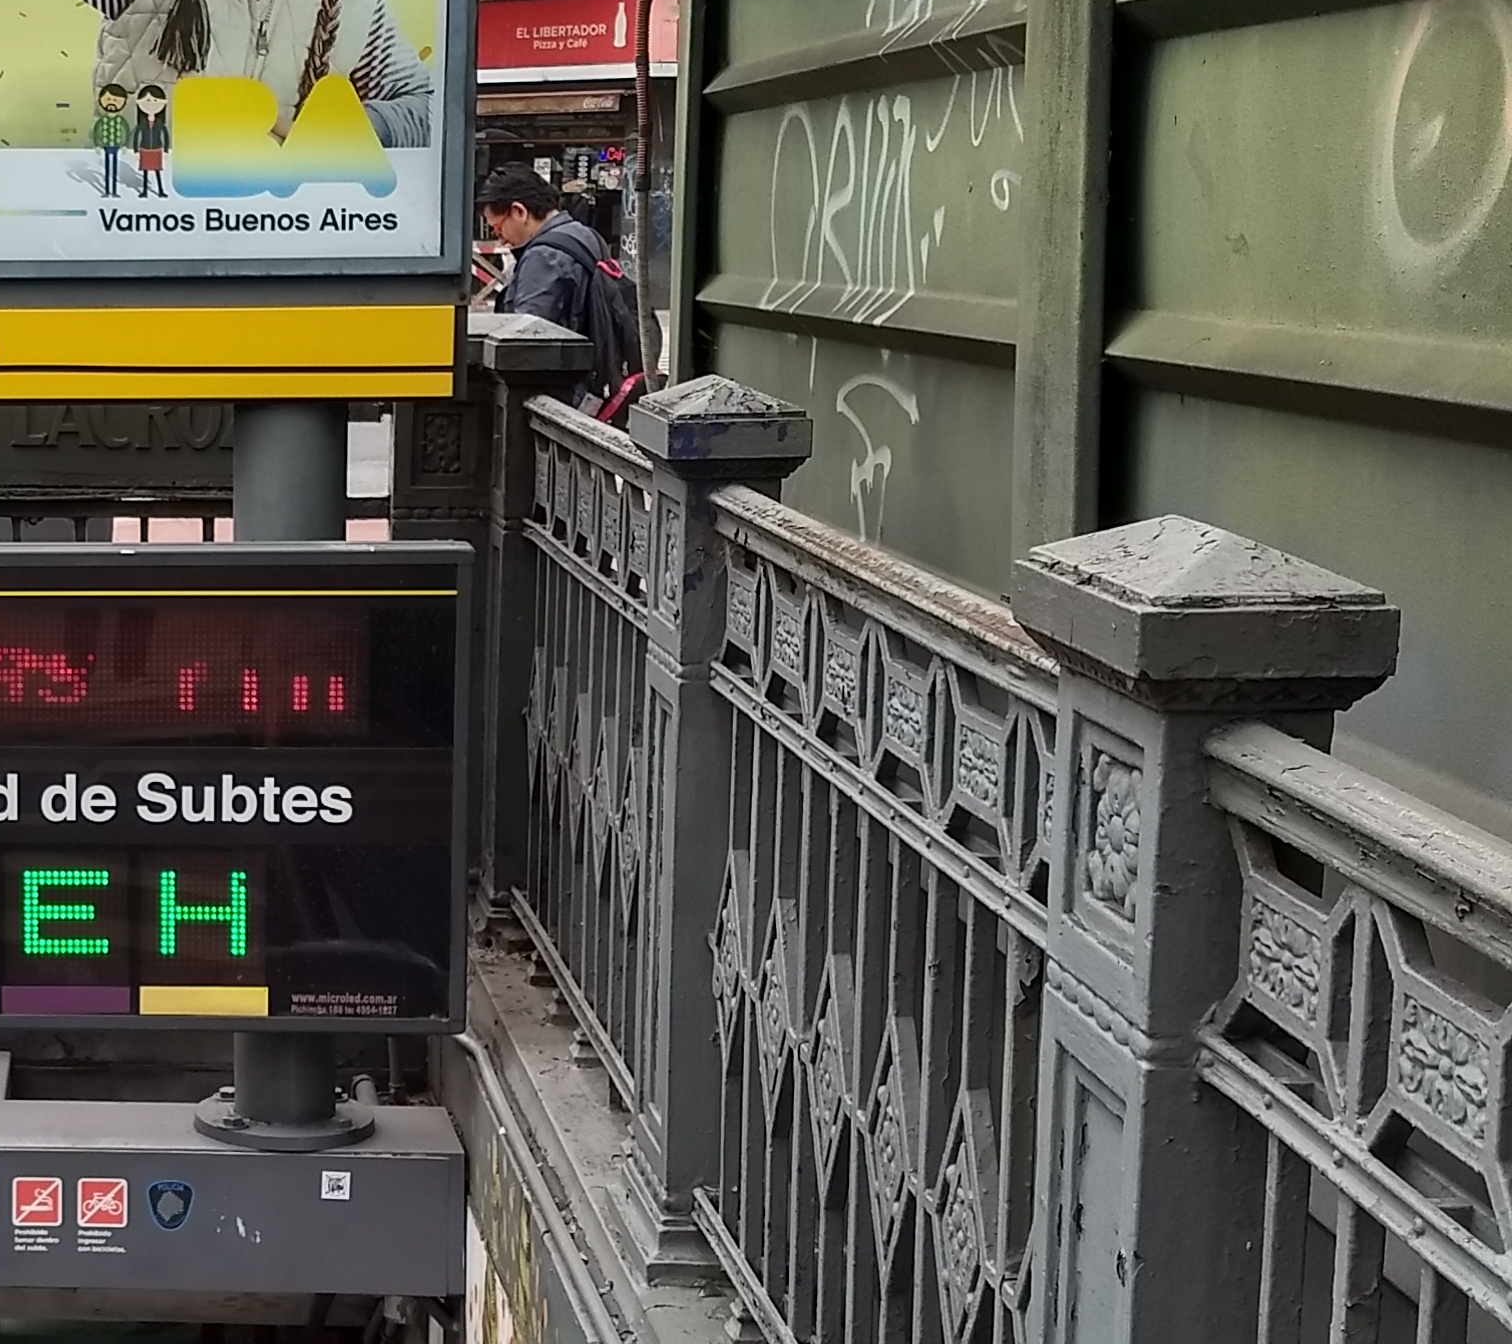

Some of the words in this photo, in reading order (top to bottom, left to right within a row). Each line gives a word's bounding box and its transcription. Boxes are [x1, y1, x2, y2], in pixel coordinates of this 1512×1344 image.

[516, 27, 530, 39] EL
[533, 24, 607, 38] LIBERTADOR
[533, 39, 557, 50] Pizza
[558, 41, 565, 51] y
[567, 38, 588, 49] Café
[99, 209, 195, 231] Vamos
[205, 208, 310, 232] Buenos
[319, 207, 398, 231] Aires
[10, 405, 235, 450] LACRO
[41, 774, 116, 822] de
[137, 773, 352, 823] Subtes
[23, 867, 110, 956] E
[159, 867, 247, 956] H
